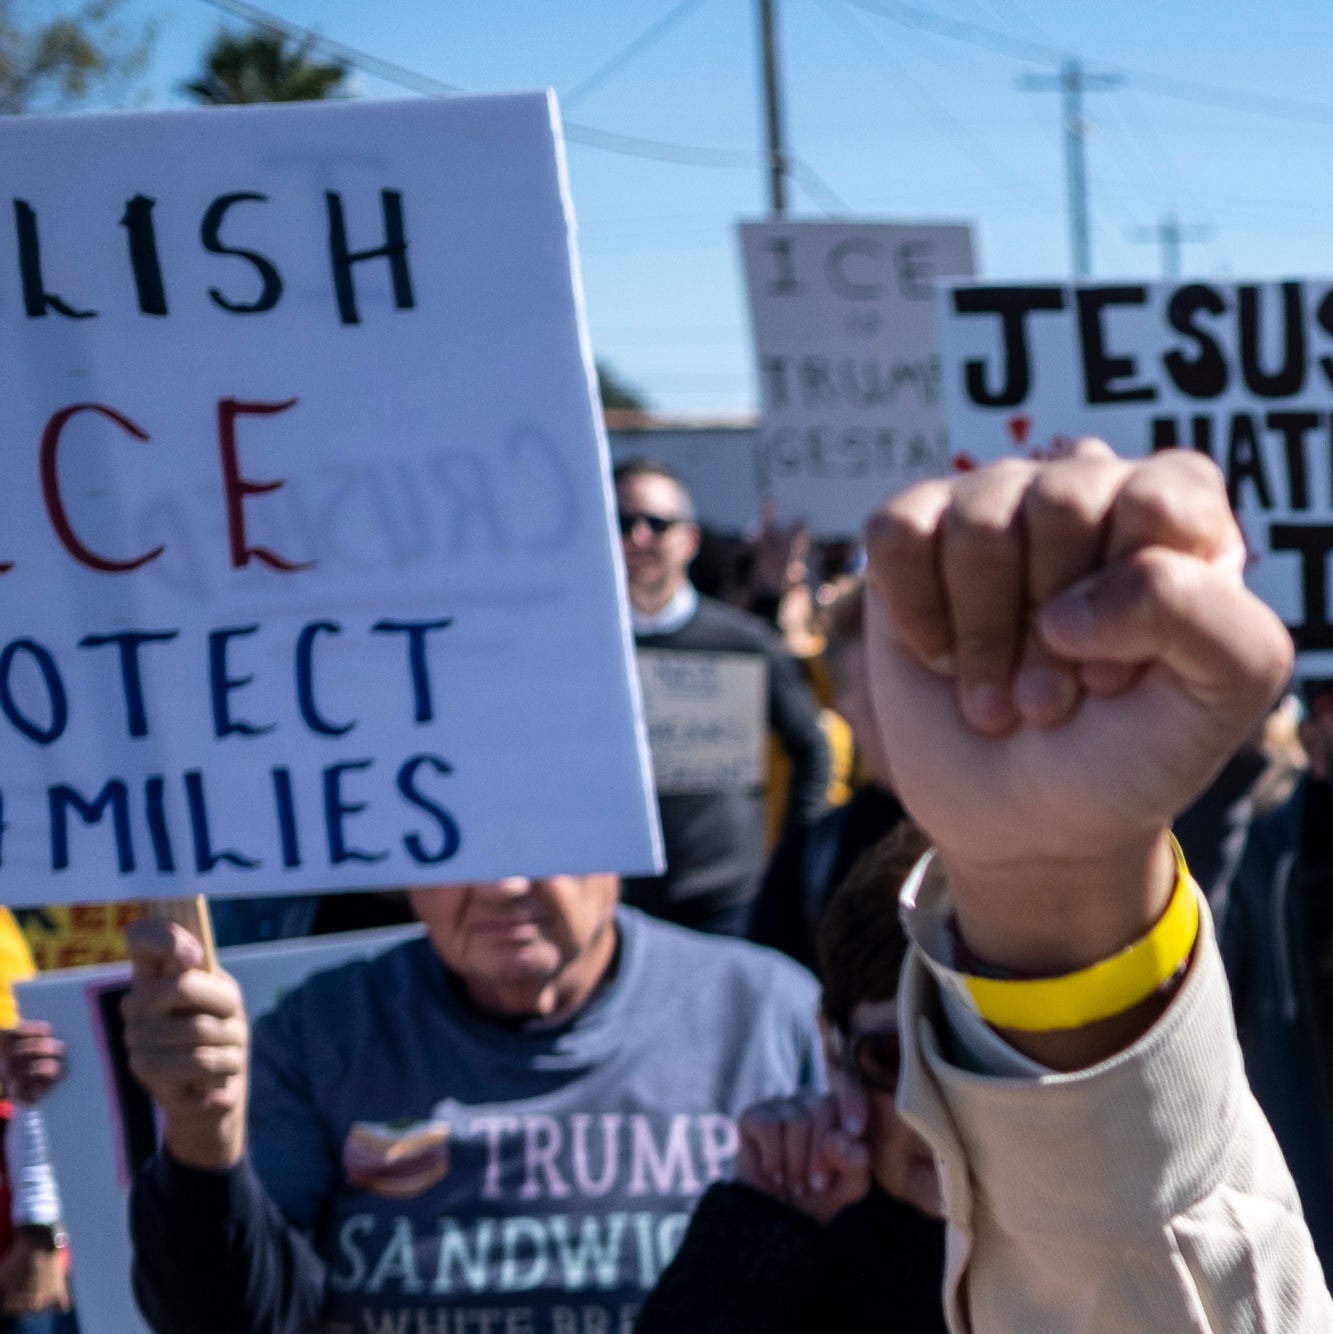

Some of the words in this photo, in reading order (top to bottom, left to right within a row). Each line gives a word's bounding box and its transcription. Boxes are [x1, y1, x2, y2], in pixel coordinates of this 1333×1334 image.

[13, 187, 416, 327] LISH
[0, 395, 318, 574] CE
[0, 752, 463, 877] MILIES
[468, 1110, 742, 1199] TRUMP
